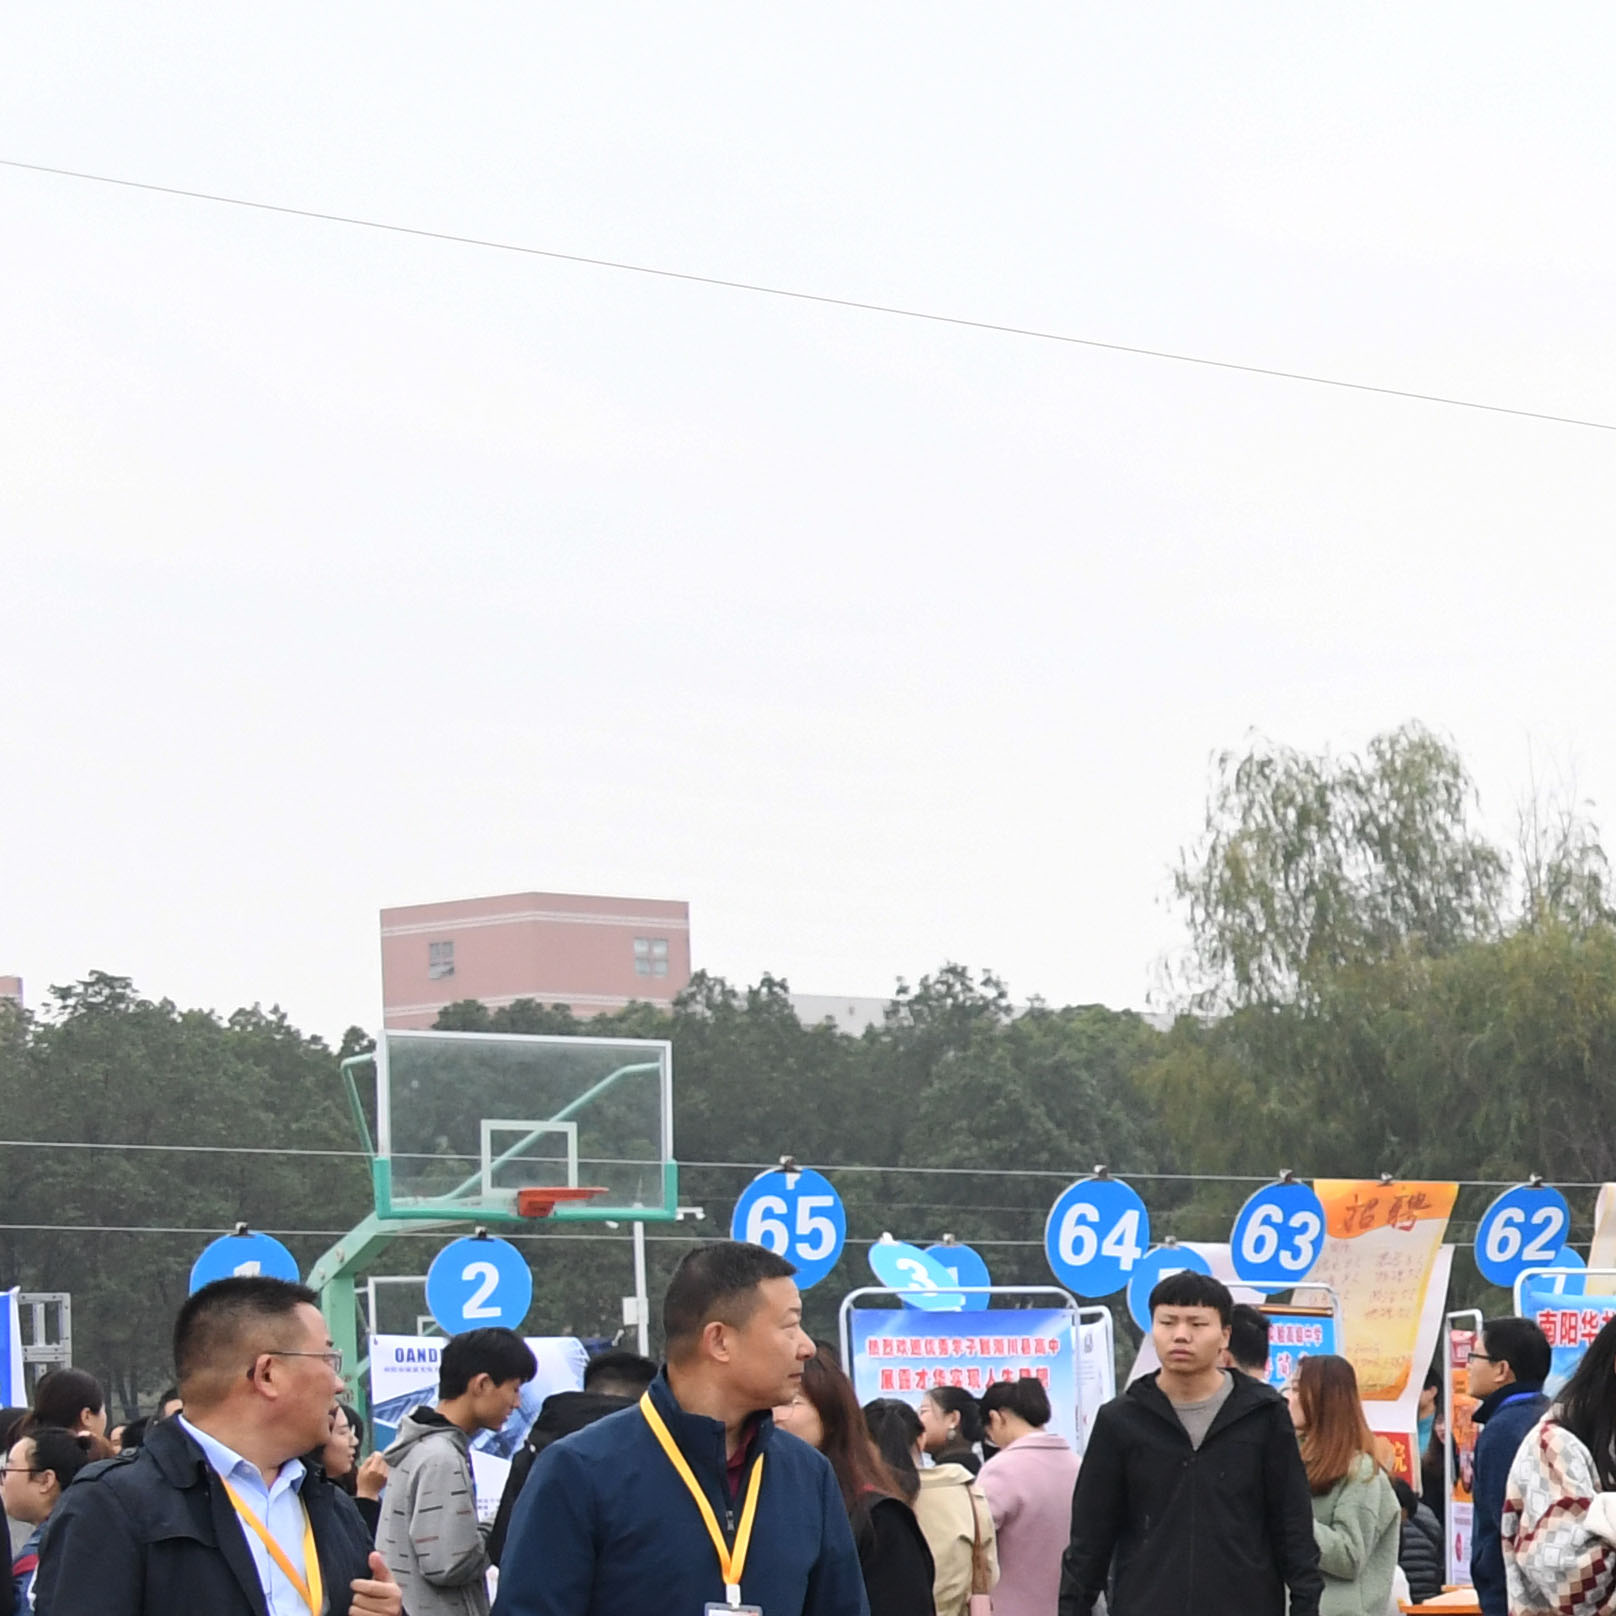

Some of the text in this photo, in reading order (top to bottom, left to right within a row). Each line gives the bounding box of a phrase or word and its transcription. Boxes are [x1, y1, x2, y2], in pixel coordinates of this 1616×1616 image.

[746, 1195, 837, 1261] 65
[1058, 1203, 1142, 1272] 64
[1242, 1204, 1321, 1271] 63
[1486, 1206, 1565, 1263] 62
[461, 1261, 503, 1320] 2
